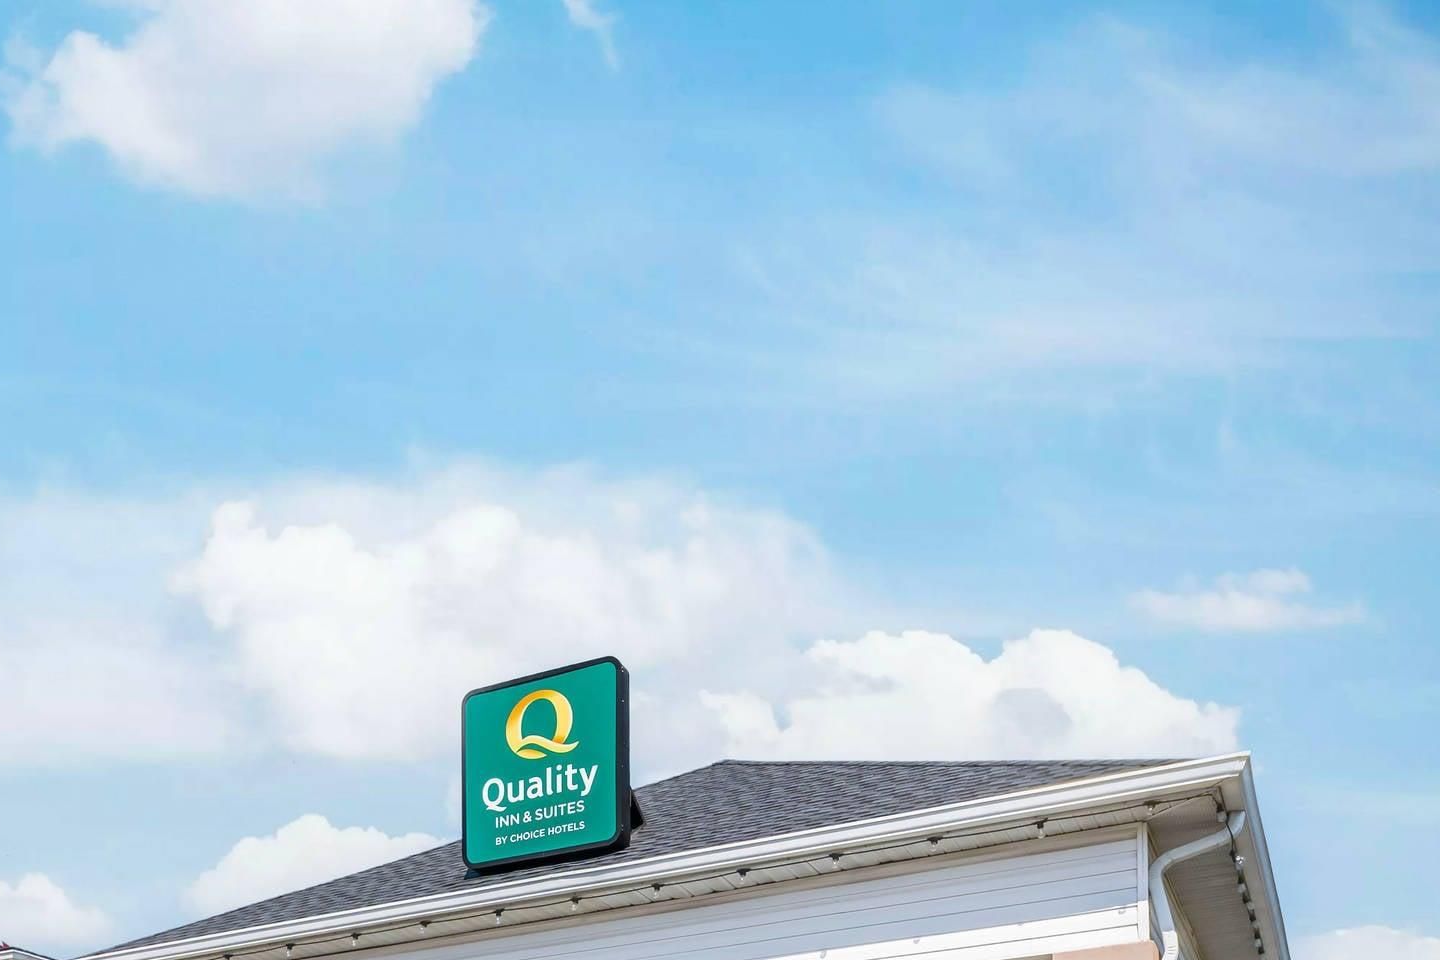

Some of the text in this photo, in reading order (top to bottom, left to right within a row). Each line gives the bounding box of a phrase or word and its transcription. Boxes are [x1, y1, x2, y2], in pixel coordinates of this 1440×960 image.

[505, 689, 580, 760] Q
[481, 763, 599, 812] Quality
[495, 800, 585, 829] INN & SUITES
[495, 821, 585, 846] BY CHOICE HOTELS
